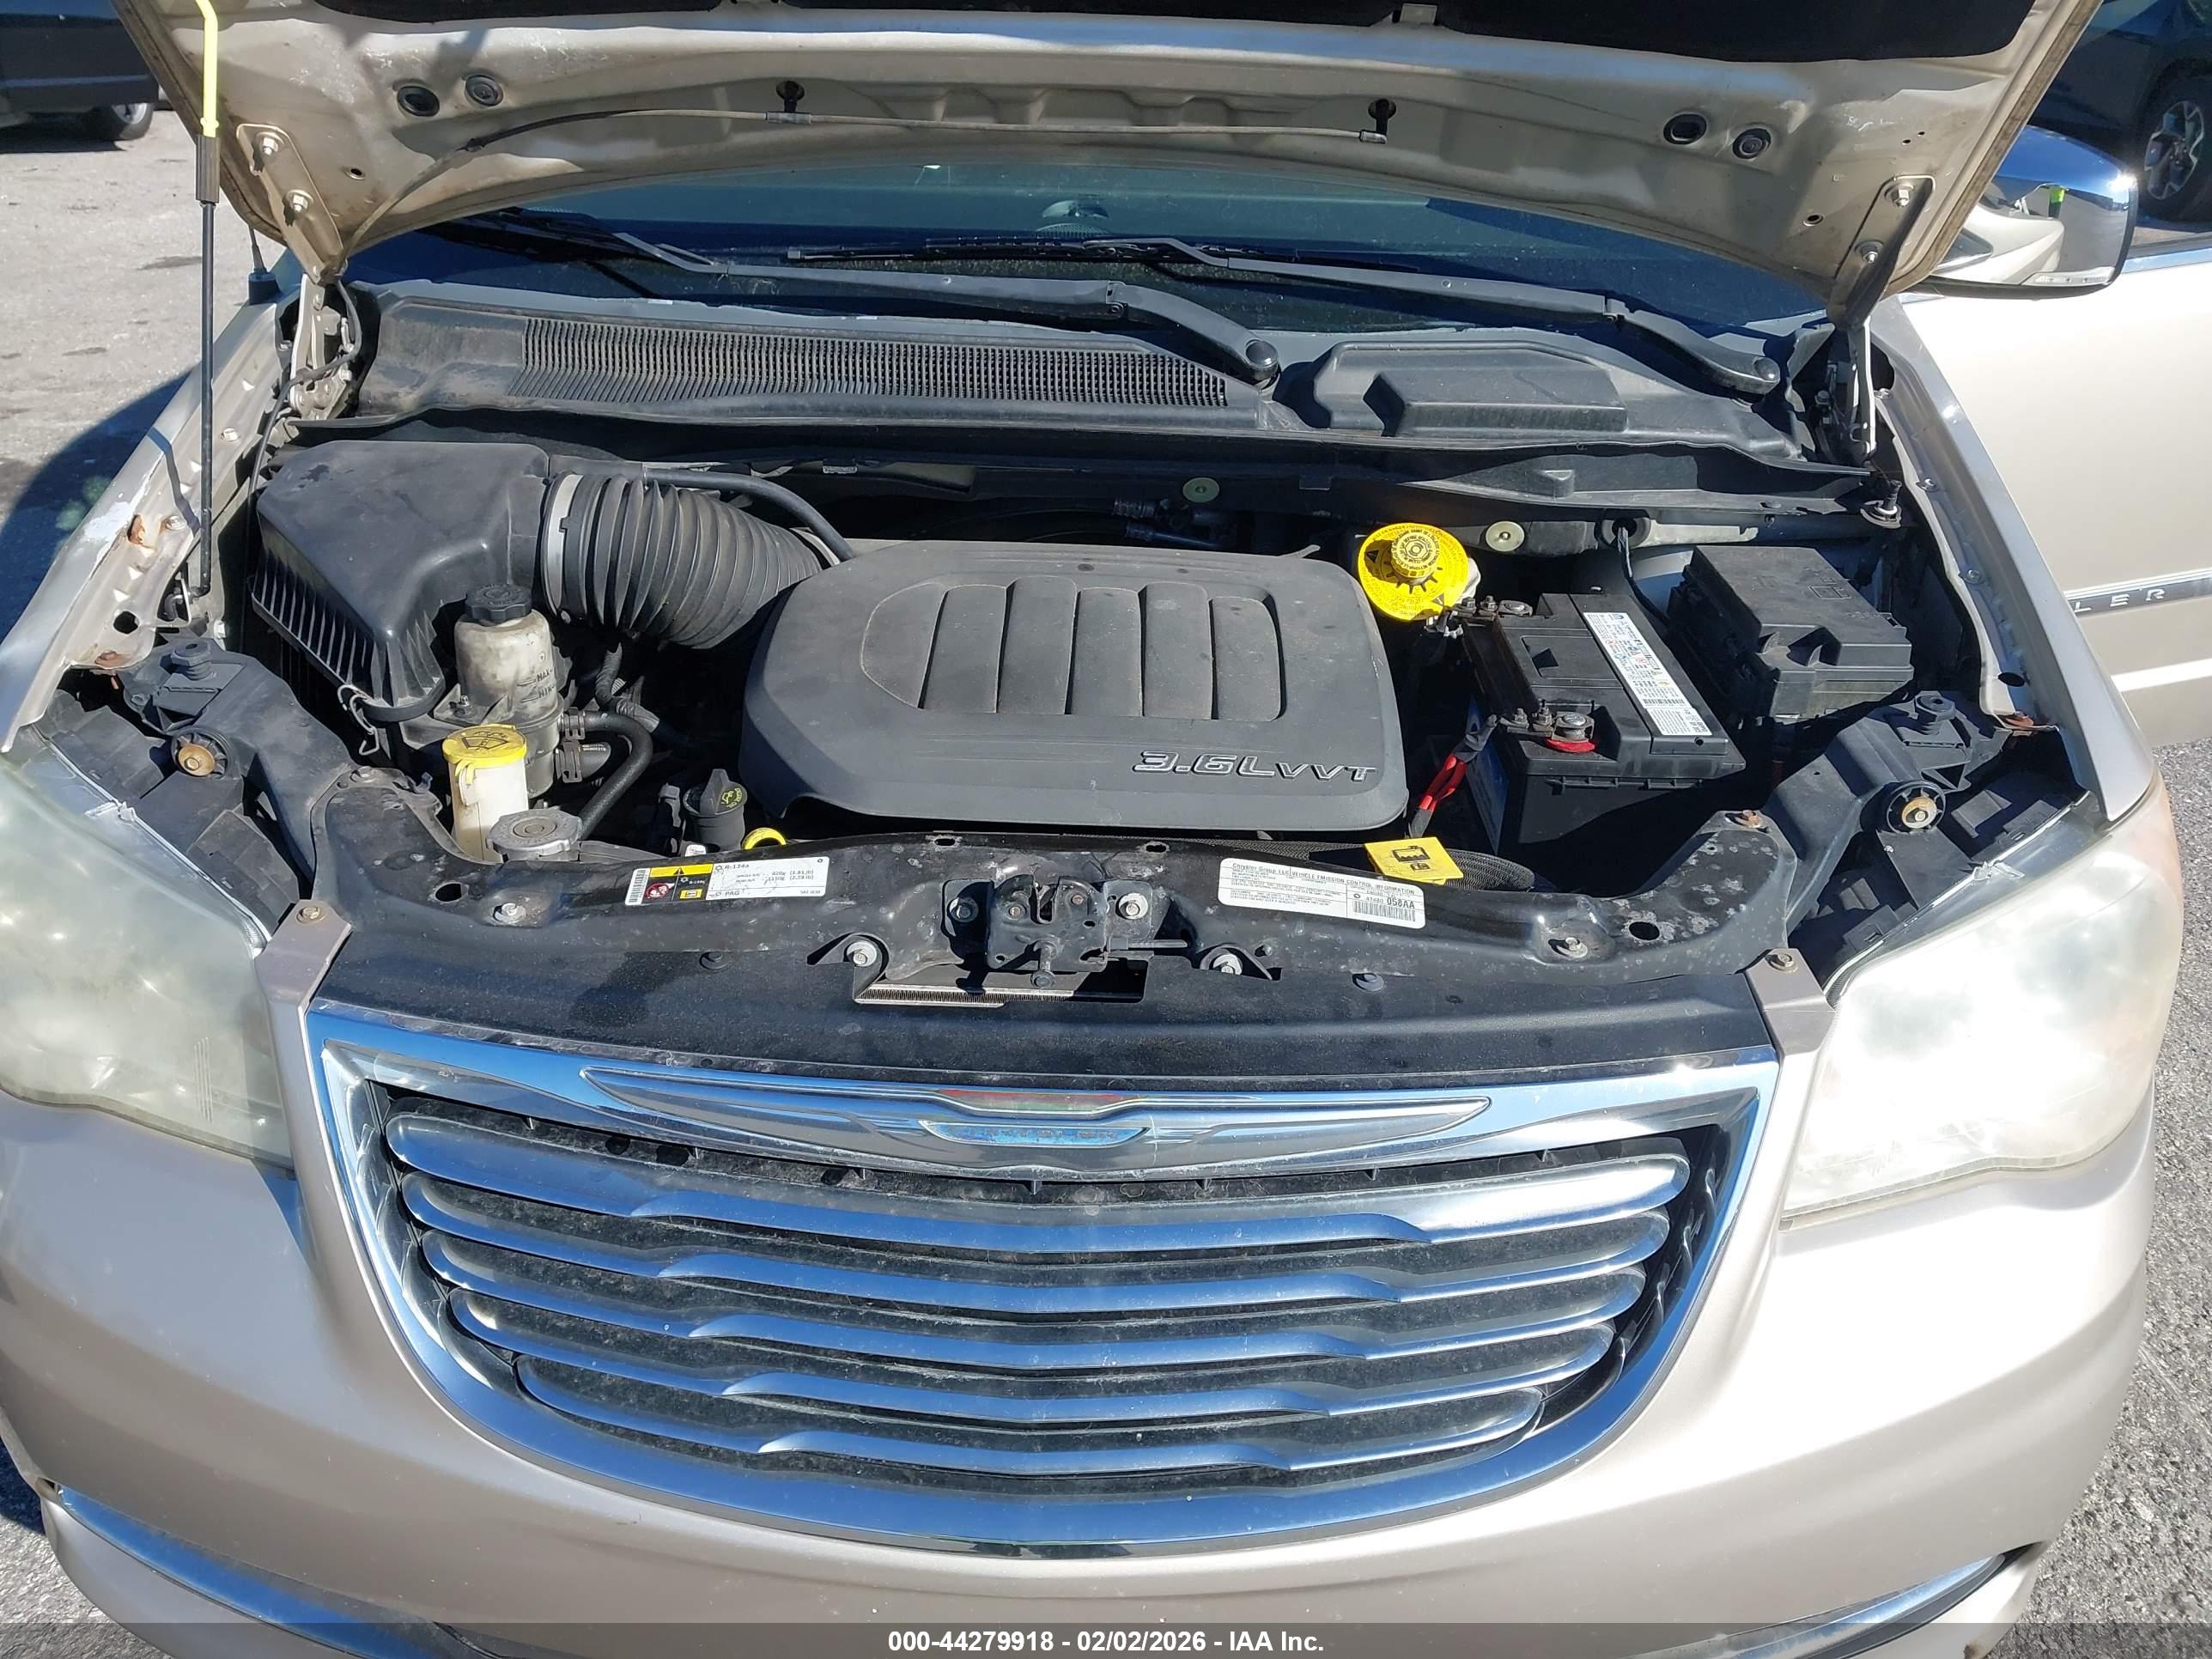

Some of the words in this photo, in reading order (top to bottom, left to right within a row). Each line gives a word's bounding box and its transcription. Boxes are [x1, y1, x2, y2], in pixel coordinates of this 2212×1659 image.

[537, 668, 550, 682] MAX
[1316, 874, 1345, 883] EMISSION
[1346, 879, 1371, 888] CONTROL
[1375, 884, 1414, 895] INFORMATION
[1387, 897, 1415, 908] 058AA
